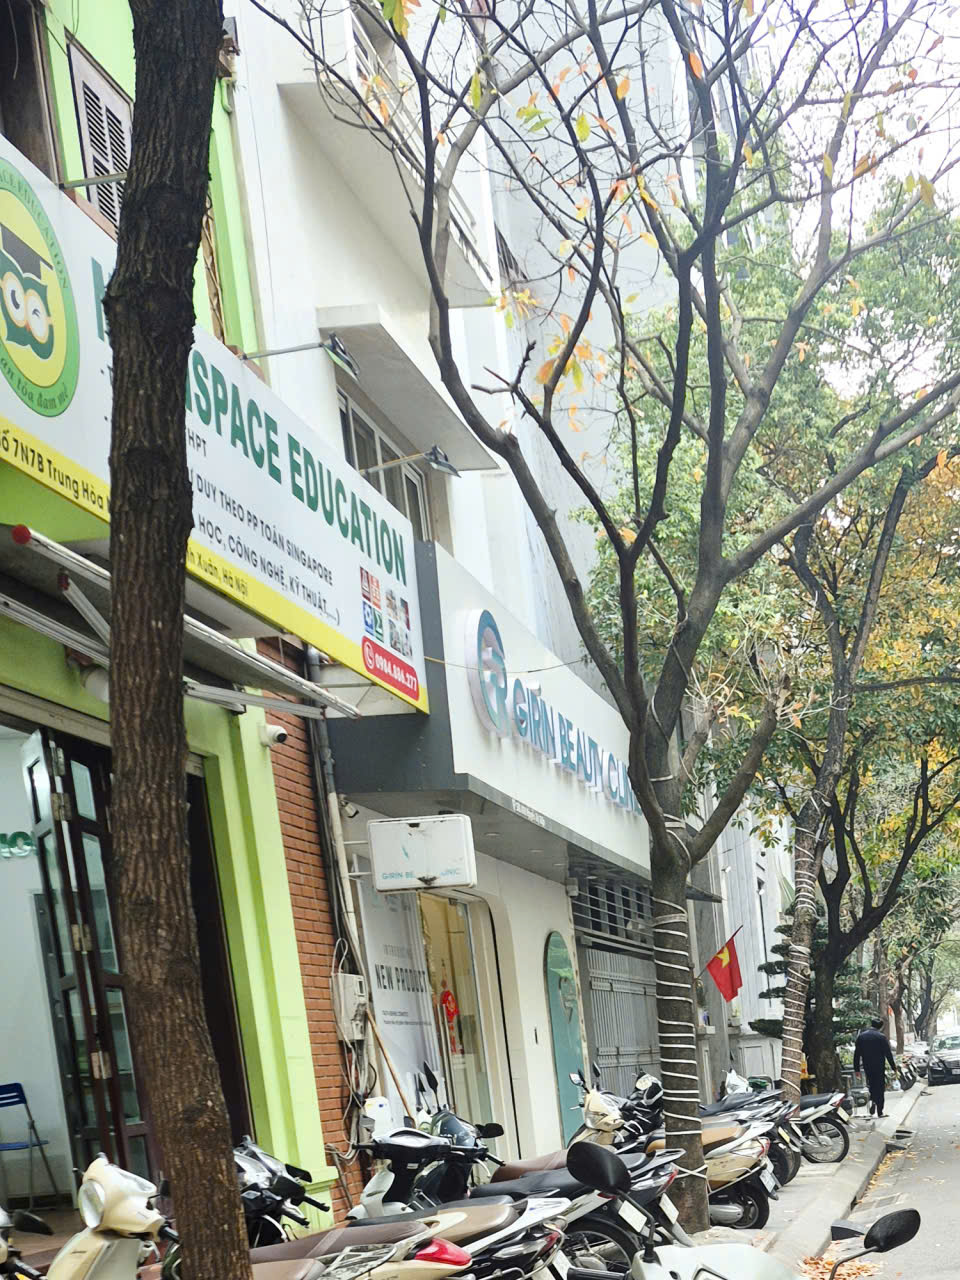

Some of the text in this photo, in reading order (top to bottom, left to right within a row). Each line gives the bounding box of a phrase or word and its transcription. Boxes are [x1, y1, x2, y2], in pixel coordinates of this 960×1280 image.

[13, 437, 44, 473] 7N7B
[47, 459, 79, 499] Trung
[81, 480, 104, 510] Hòa
[185, 349, 407, 586] SPACE EDUCATION
[187, 427, 207, 457] HPT
[197, 473, 217, 499] DUY
[219, 490, 245, 522] THEO
[247, 510, 258, 531] PP
[286, 539, 333, 586] SINGAPORE
[228, 534, 258, 568] CÔNG
[513, 678, 556, 759] GIRIN
[558, 712, 604, 793] BEAUTY
[375, 964, 394, 990] NEW
